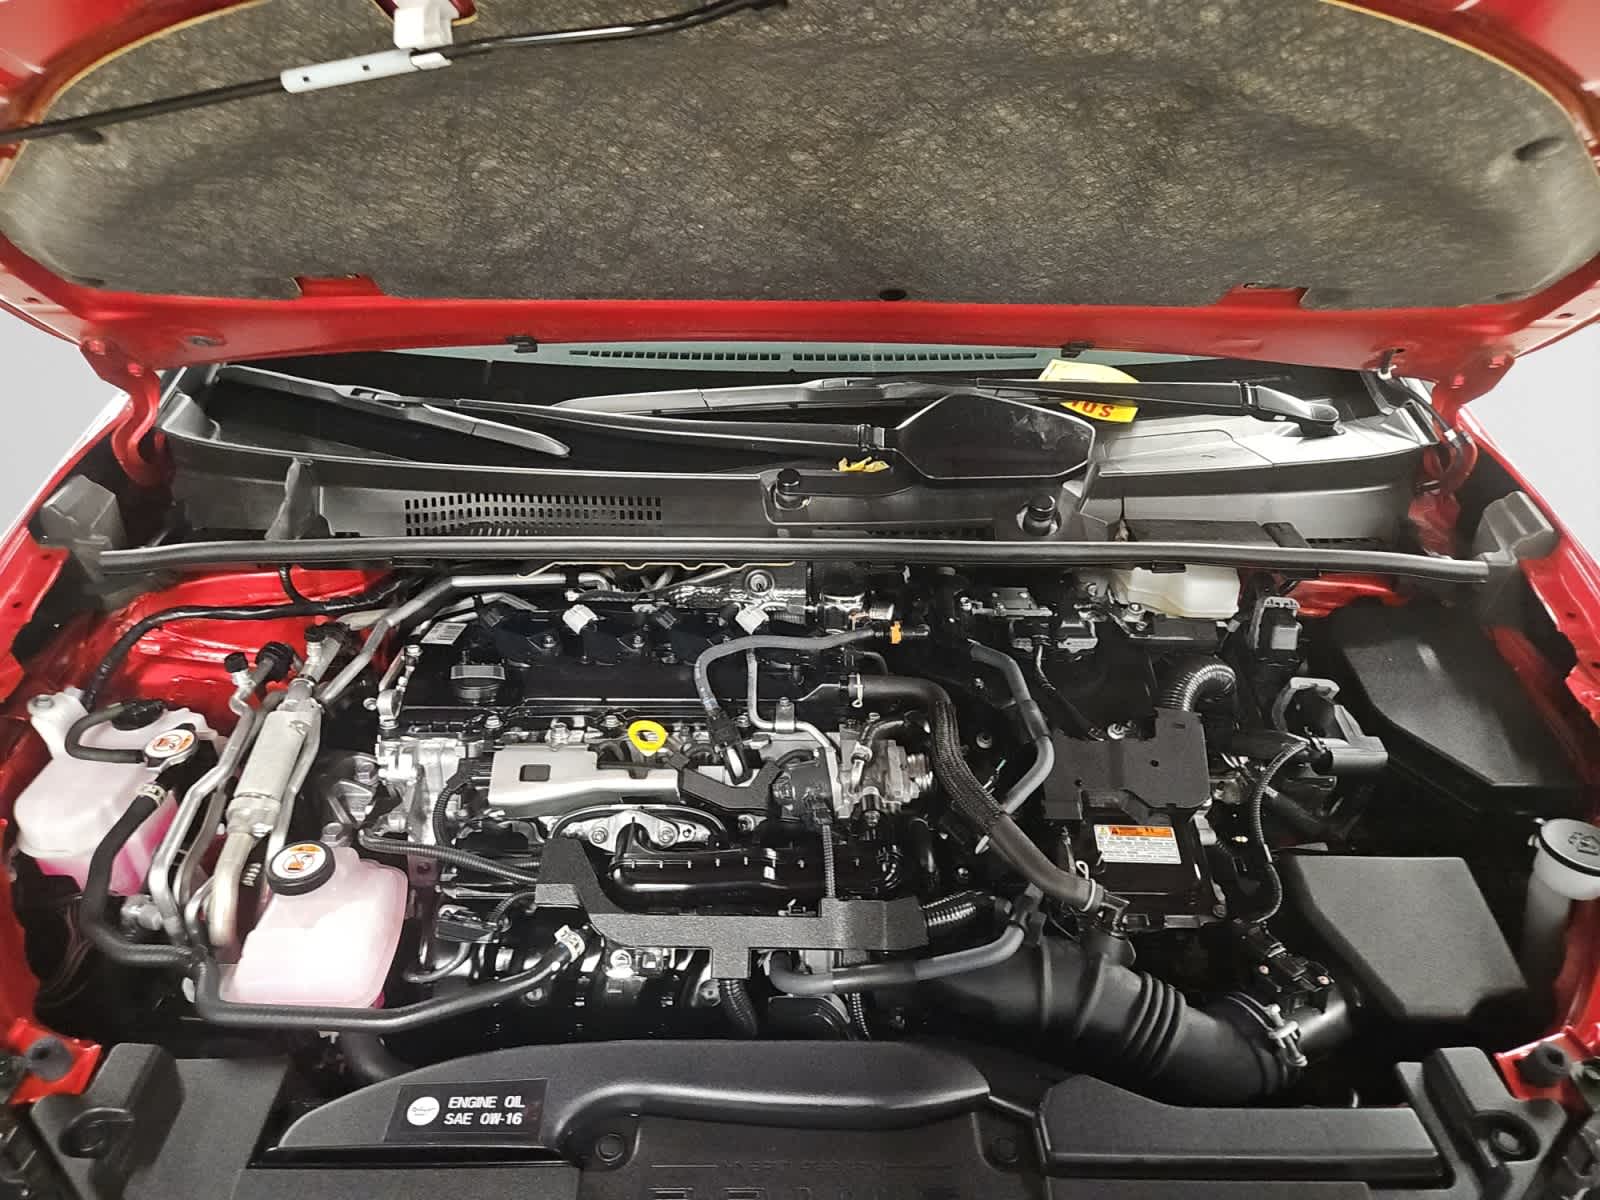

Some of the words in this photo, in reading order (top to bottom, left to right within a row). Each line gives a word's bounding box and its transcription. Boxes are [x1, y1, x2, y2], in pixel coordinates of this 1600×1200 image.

[448, 1096, 498, 1109] ENGINE
[504, 1096, 526, 1108] OIL
[444, 1112, 474, 1125] SAE
[479, 1112, 523, 1125] 0W-16
